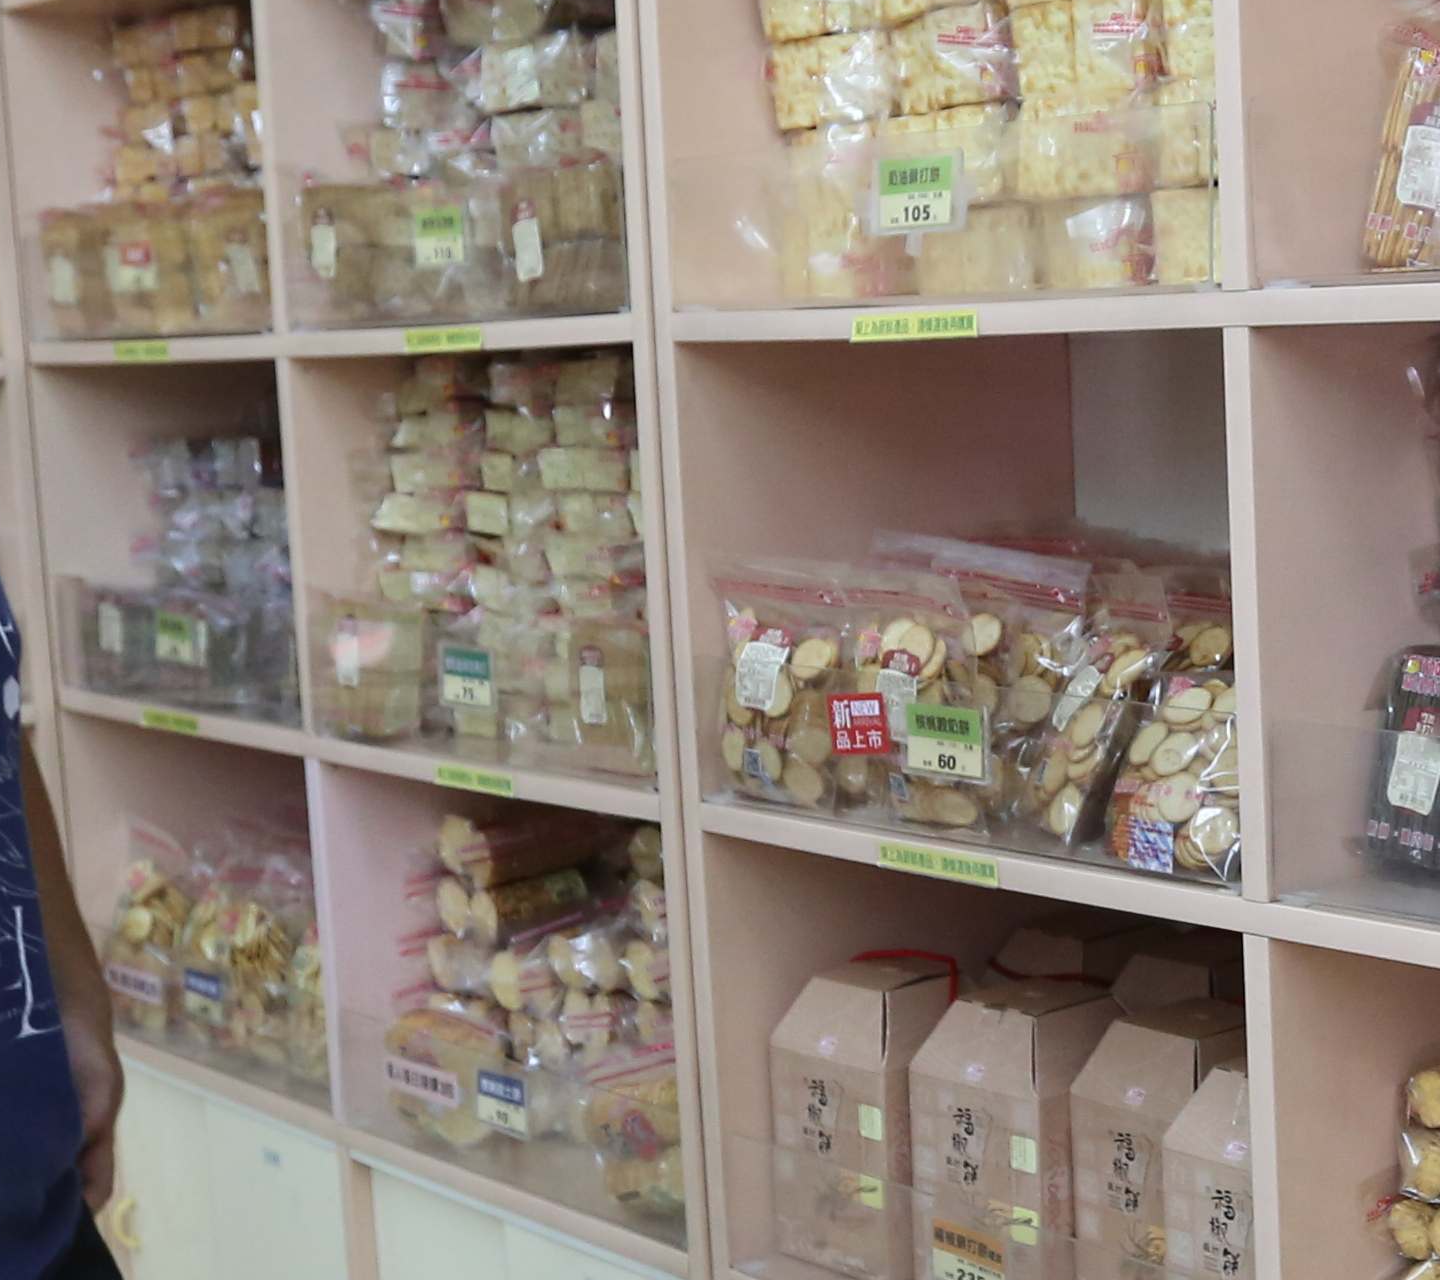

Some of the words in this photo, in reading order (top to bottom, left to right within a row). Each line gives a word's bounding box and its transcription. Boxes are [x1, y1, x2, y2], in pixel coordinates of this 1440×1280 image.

[902, 204, 932, 223] 105
[831, 700, 852, 729] 新
[851, 701, 879, 716] NEW
[835, 730, 883, 750] 品上市
[937, 753, 957, 771] 60
